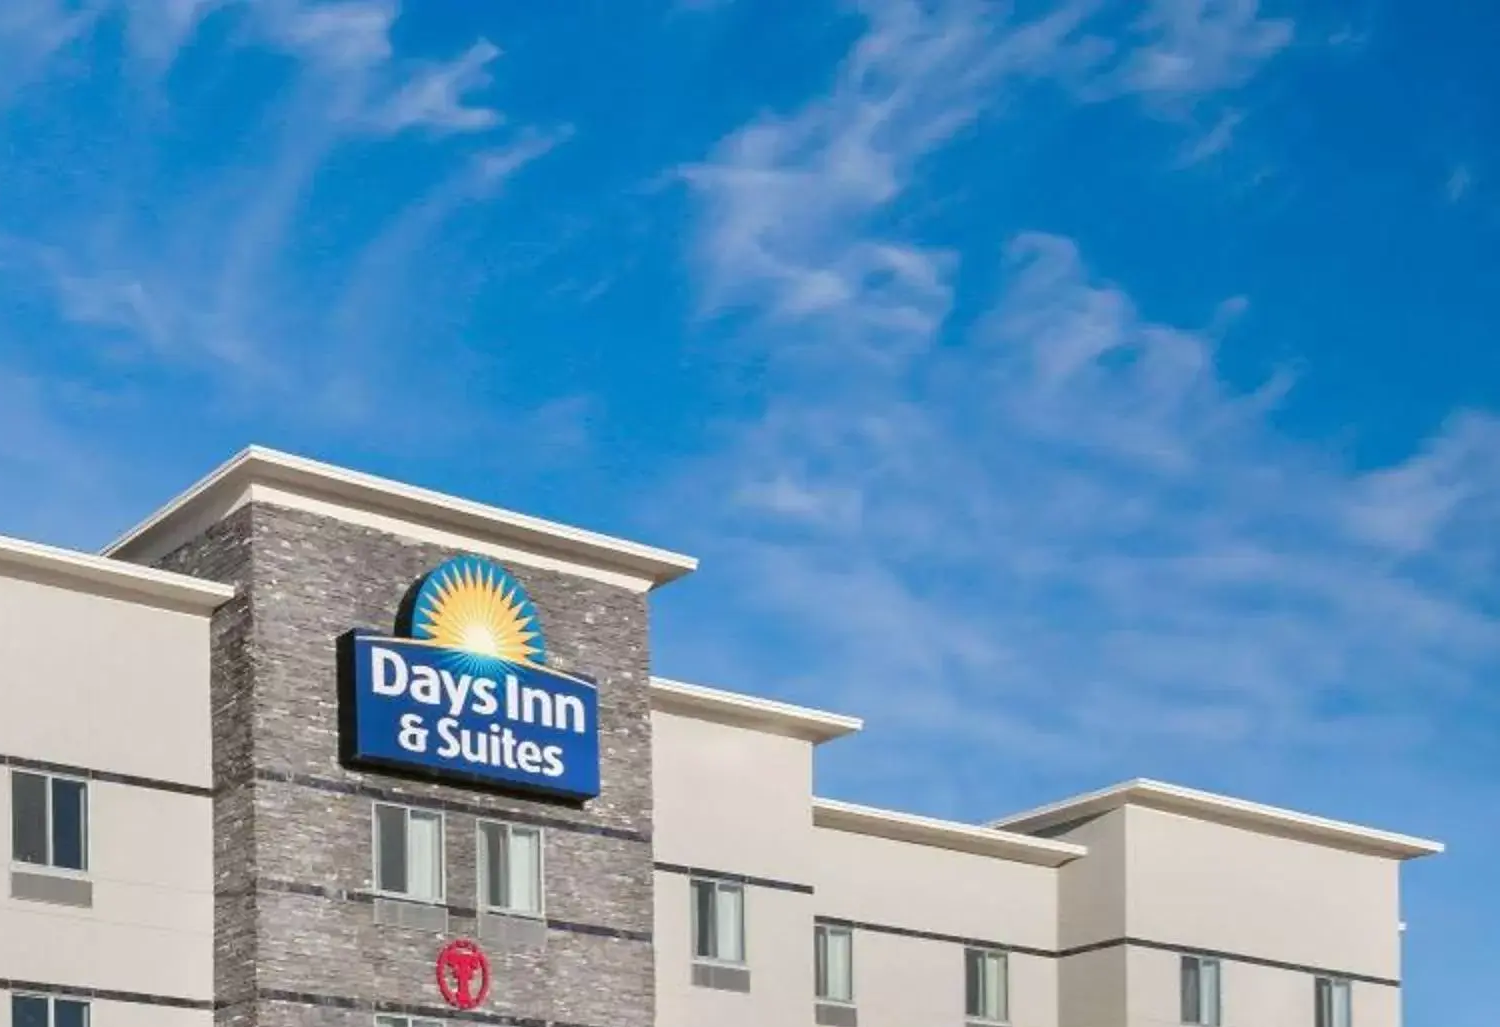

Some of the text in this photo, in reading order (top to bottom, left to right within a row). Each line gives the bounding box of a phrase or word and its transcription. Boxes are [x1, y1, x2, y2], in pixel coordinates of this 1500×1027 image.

[371, 646, 586, 734] Days Inn
[398, 713, 564, 778] & Suites
